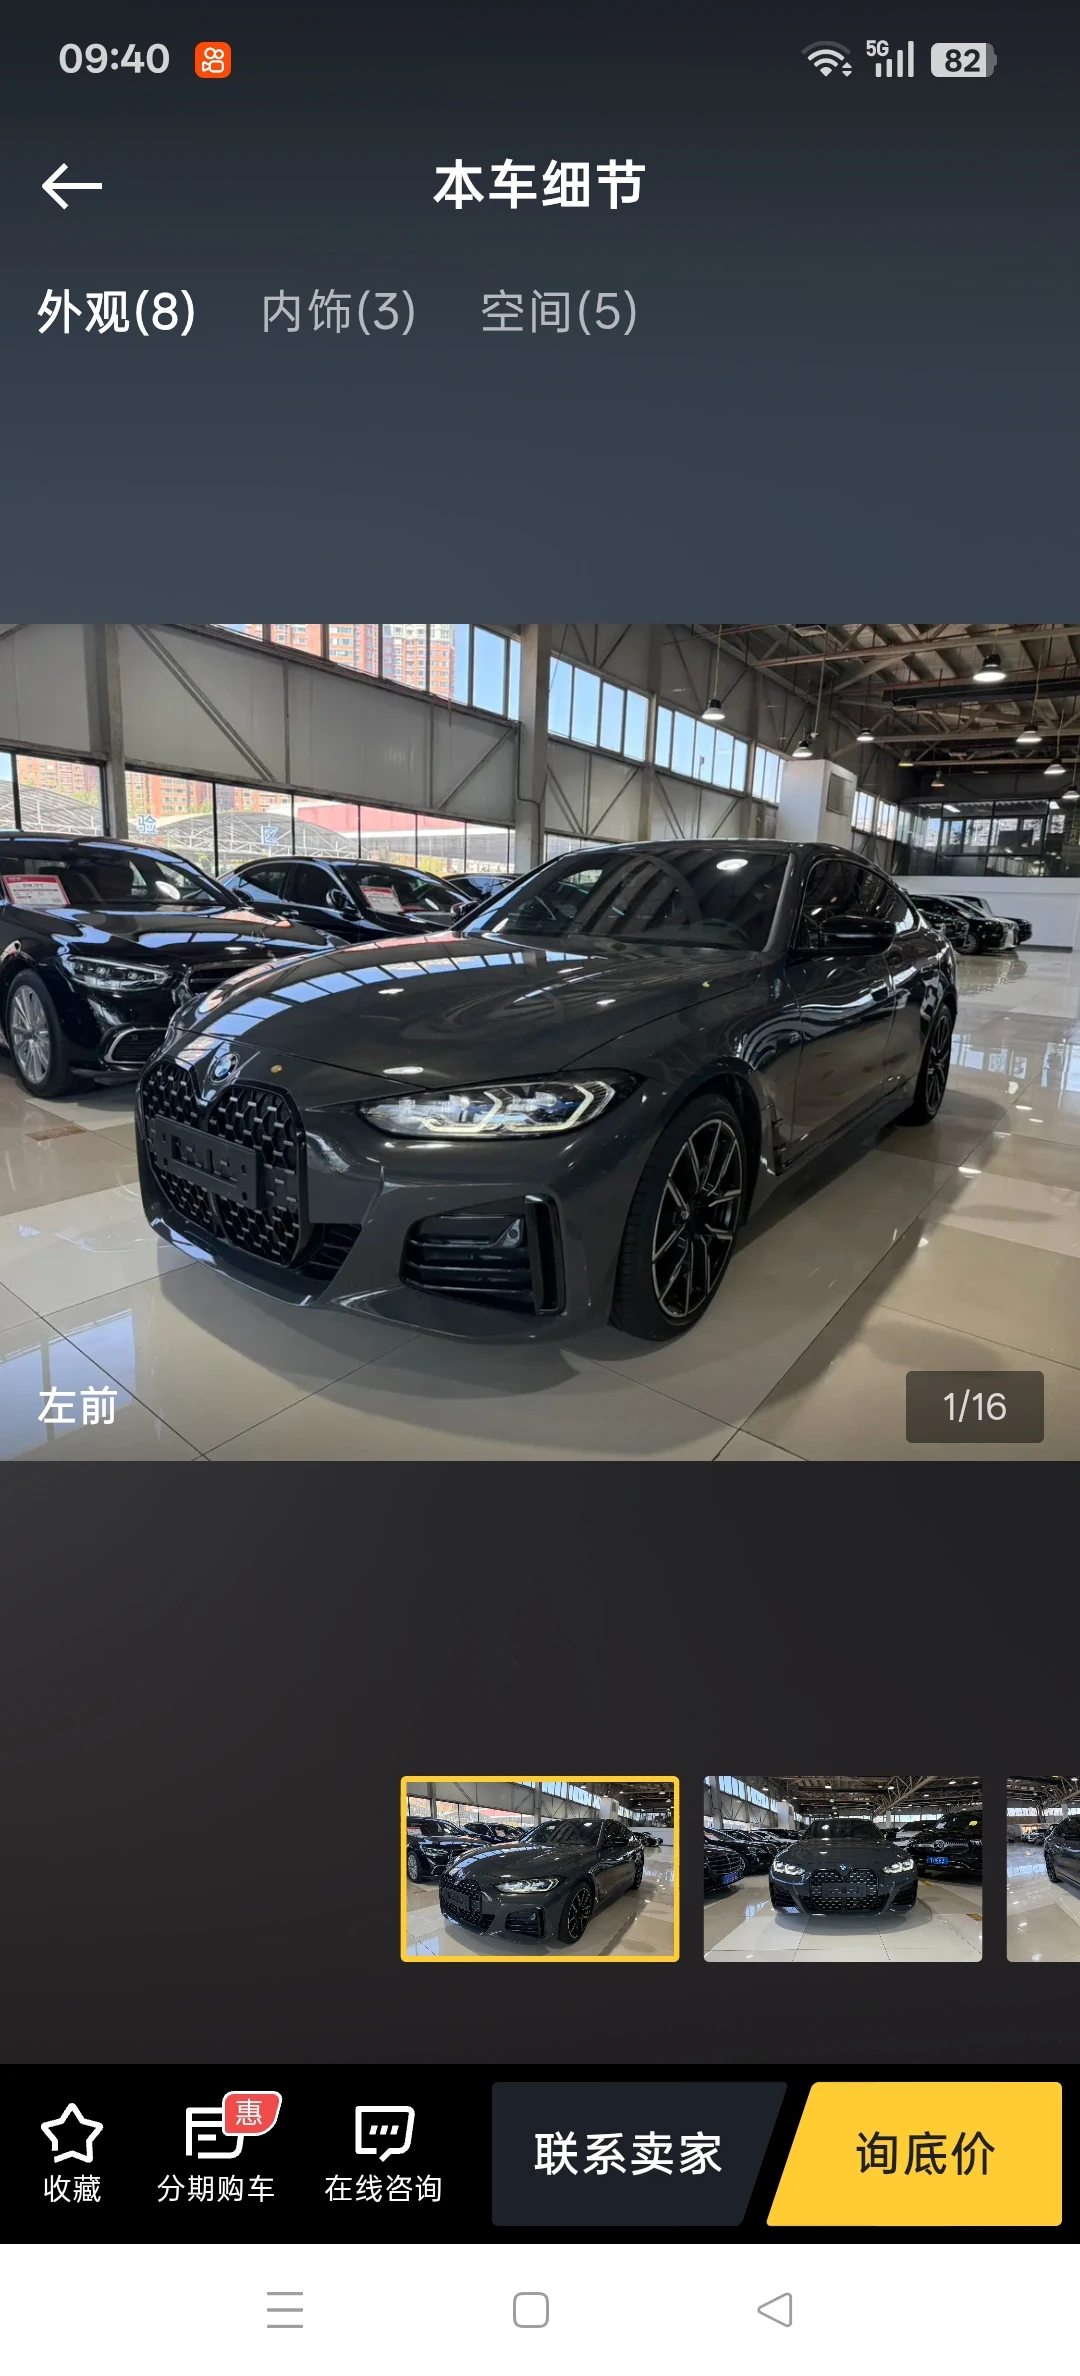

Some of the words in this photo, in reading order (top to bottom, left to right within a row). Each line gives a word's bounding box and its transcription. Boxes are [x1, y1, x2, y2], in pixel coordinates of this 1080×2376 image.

[58, 43, 171, 75] 09:40
[865, 39, 890, 57] 5G
[944, 48, 981, 73] 82
[432, 157, 647, 211] 本车细节
[36, 287, 196, 337] 外观(8)
[262, 287, 416, 337] 内饰(3)
[480, 287, 638, 337] 空间(5)
[235, 2098, 263, 2126] 惠
[532, 2129, 724, 2177] 联系卖家
[855, 2129, 997, 2177] 询底价
[42, 2172, 102, 2205] 收藏
[155, 2172, 276, 2204] 分期购车
[324, 2172, 443, 2204] 在线咨询
